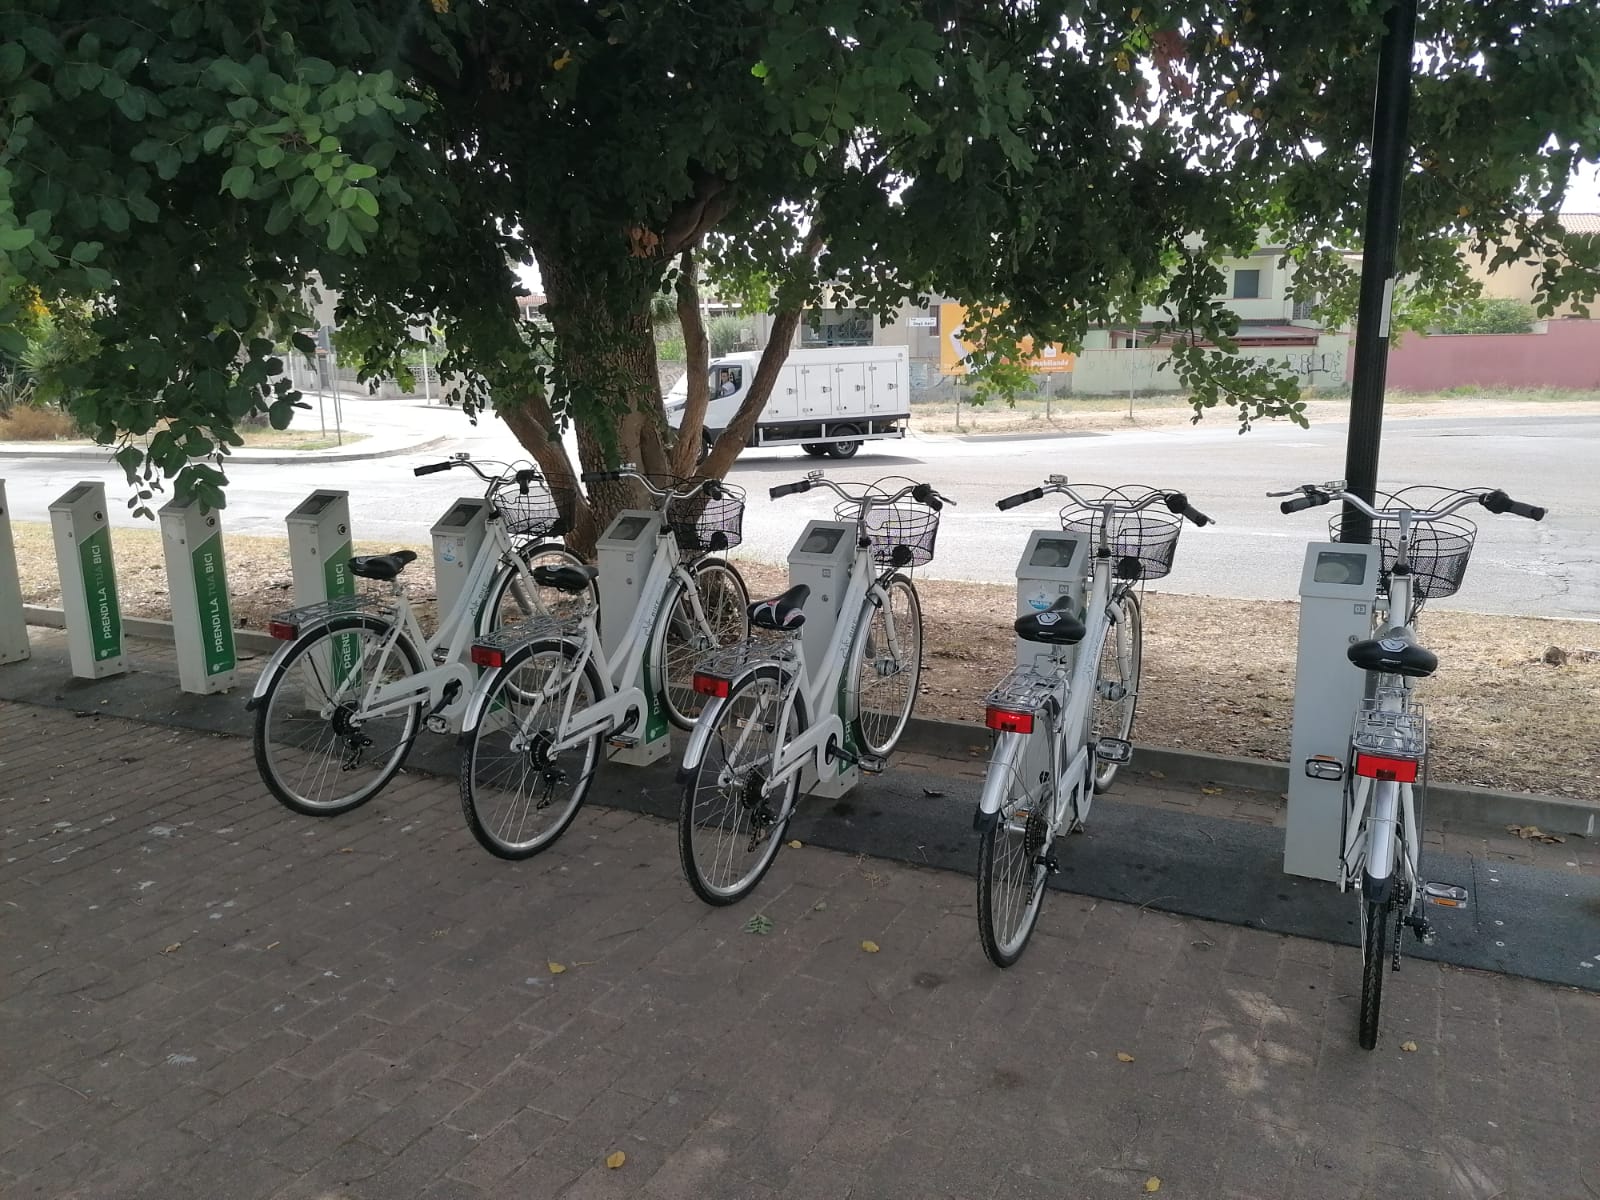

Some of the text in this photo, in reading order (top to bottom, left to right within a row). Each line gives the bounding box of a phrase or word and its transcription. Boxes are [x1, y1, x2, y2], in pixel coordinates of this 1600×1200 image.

[91, 545, 102, 564] BICI
[96, 565, 104, 586] TUA
[335, 563, 345, 585] BICI
[98, 587, 107, 601] LA
[204, 553, 224, 652] PRENDI LA TUA BICI
[1355, 605, 1365, 613] 03
[99, 602, 113, 639] PRENDI
